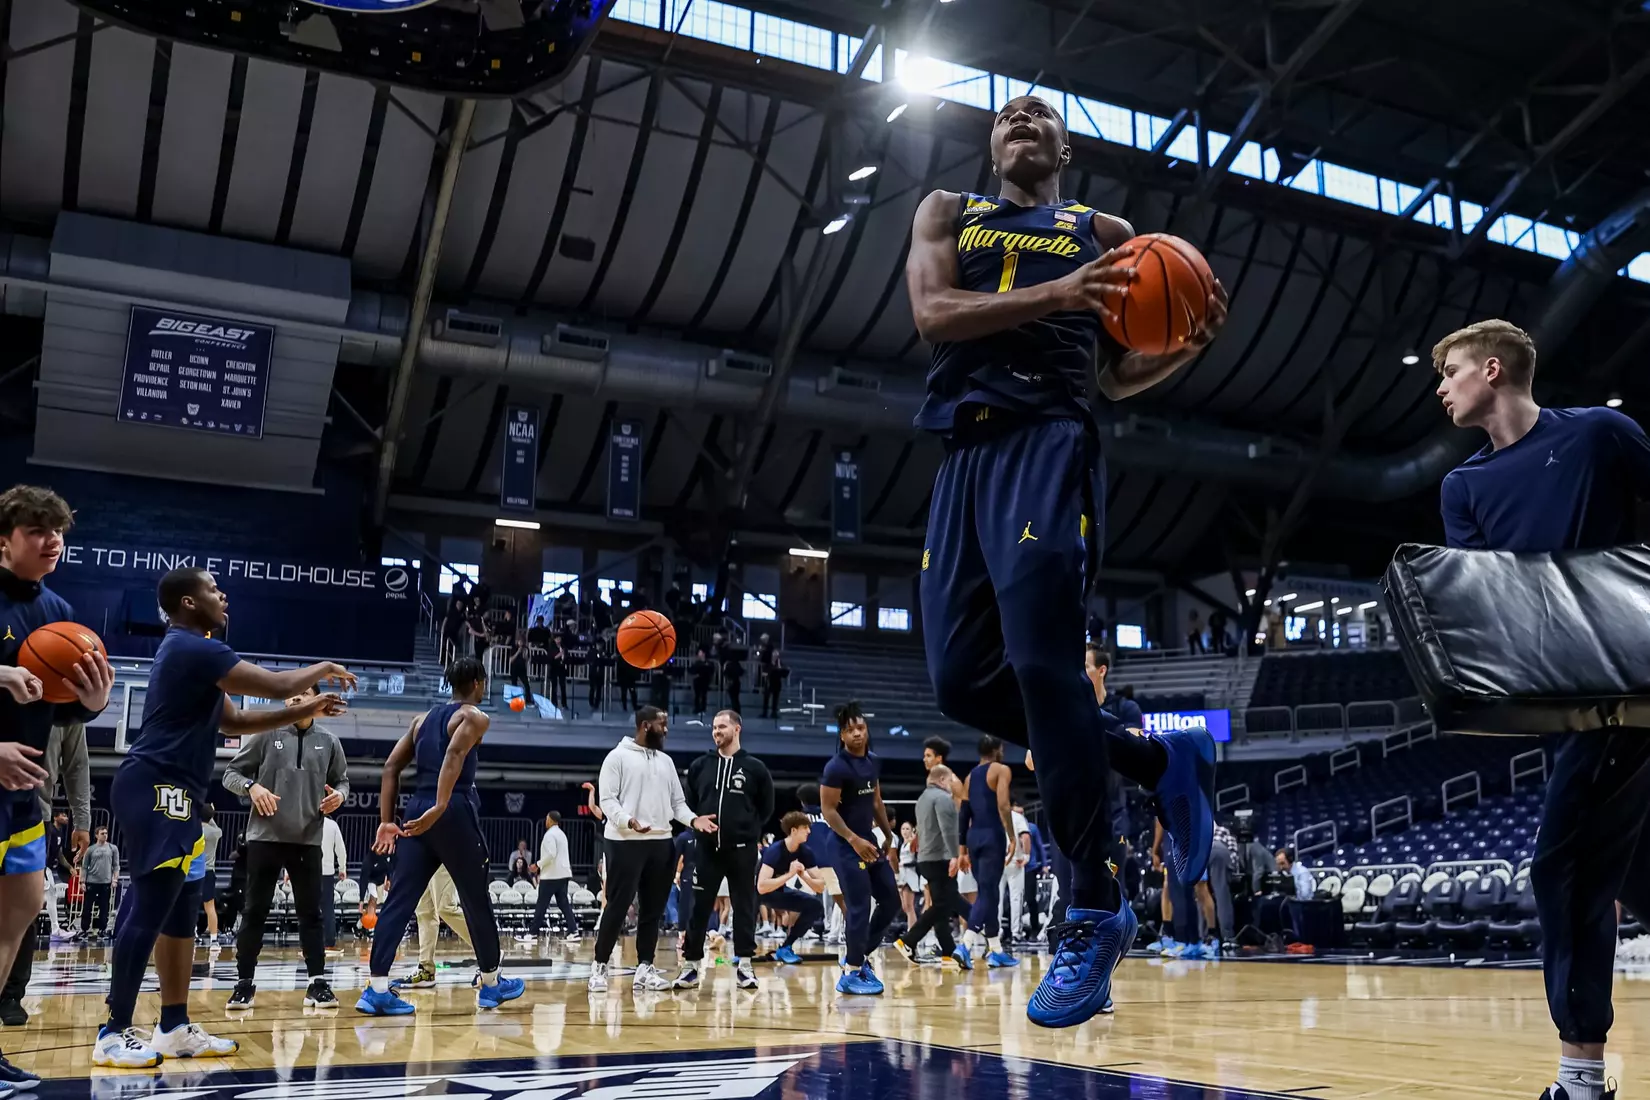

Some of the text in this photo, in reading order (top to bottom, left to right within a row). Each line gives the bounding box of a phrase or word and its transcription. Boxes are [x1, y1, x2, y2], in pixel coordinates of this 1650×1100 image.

[958, 224, 1081, 258] Marquette
[997, 251, 1019, 293] 1
[156, 317, 255, 341] BIG EAST
[195, 338, 247, 350] CONFERENCE
[150, 349, 172, 360] BUTLER
[189, 354, 209, 365] UCONN
[149, 362, 170, 373] DEPAUL
[225, 359, 256, 372] CREIGHTON
[133, 373, 169, 386] PROVIDENCE
[178, 366, 217, 380] GEORGETOWN
[223, 372, 257, 385] MARQUETTE
[179, 379, 212, 392] SETON HALL
[136, 387, 168, 400] VILLANOVA
[221, 398, 241, 409] XAVIER
[509, 421, 534, 439] NCAA
[92, 548, 126, 568] TO
[228, 559, 376, 588] FIELDHOUSE
[1143, 712, 1206, 732] Hilton
[157, 786, 190, 820] MU
